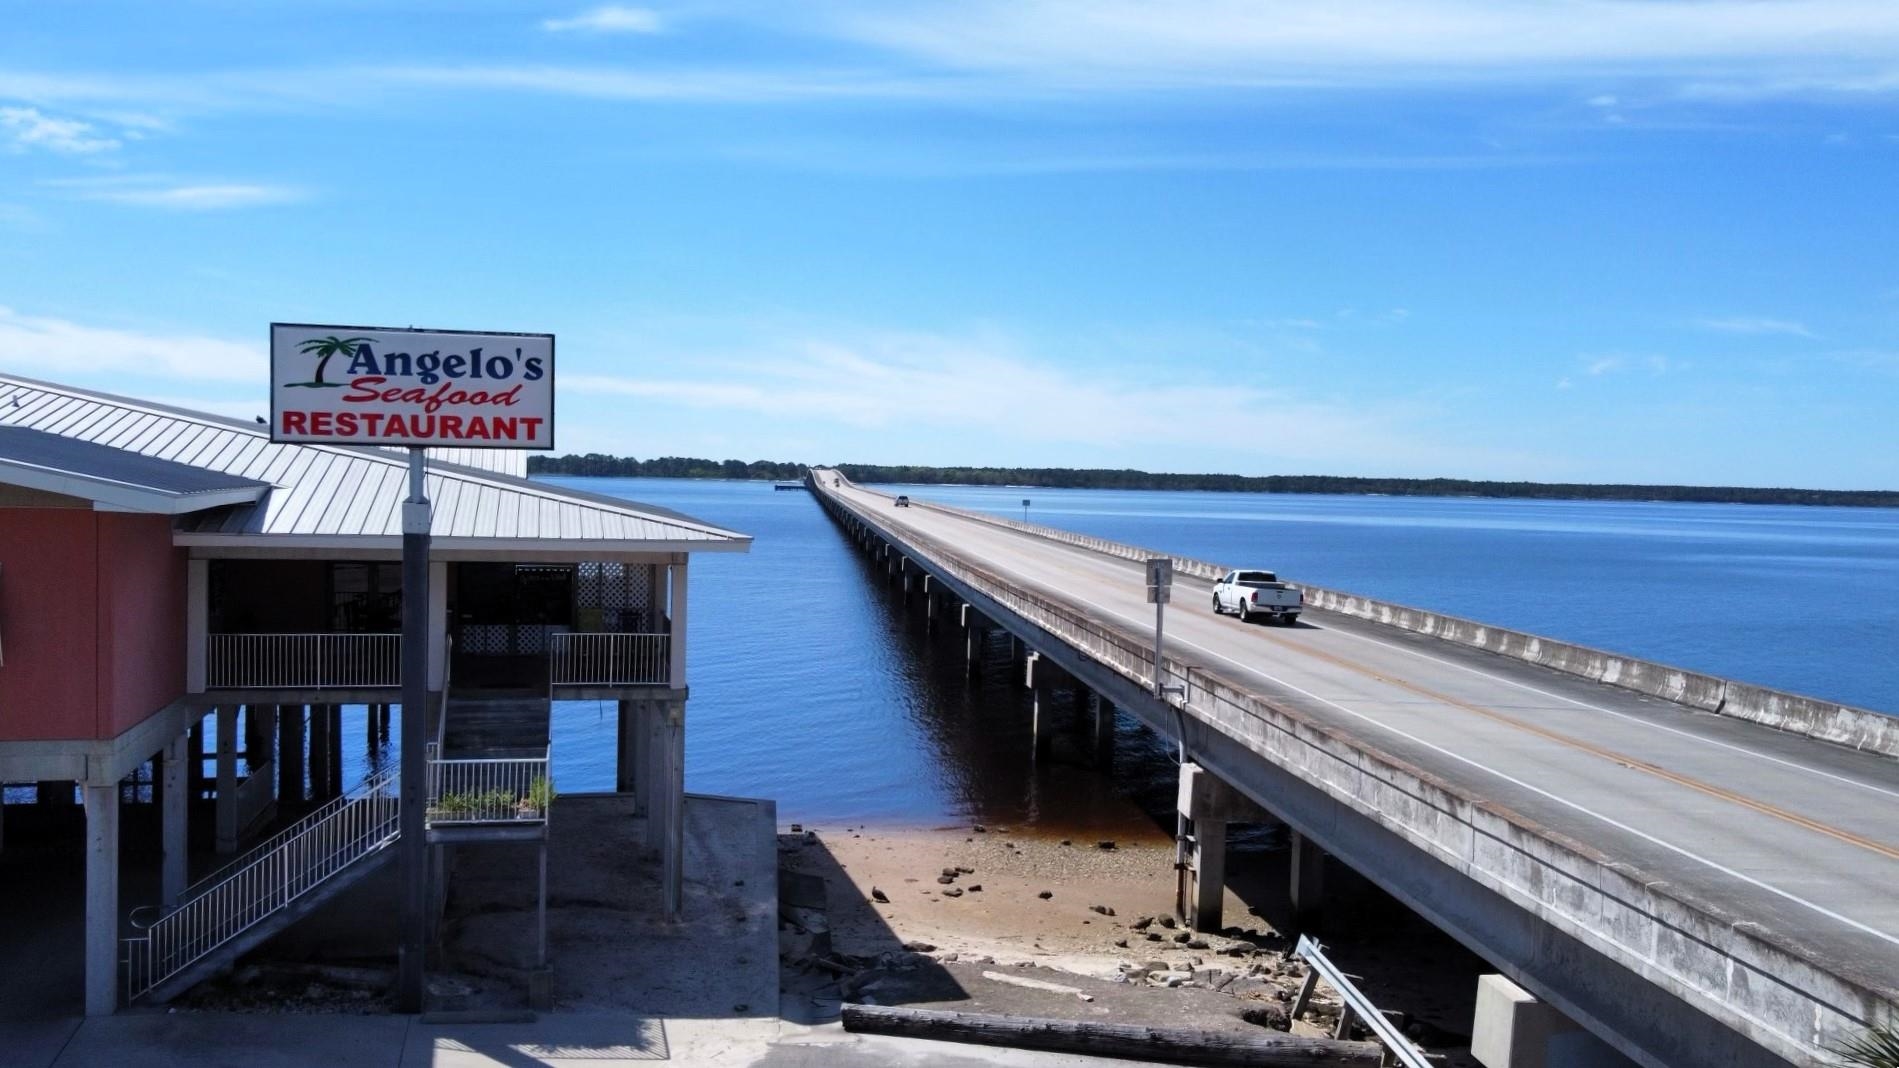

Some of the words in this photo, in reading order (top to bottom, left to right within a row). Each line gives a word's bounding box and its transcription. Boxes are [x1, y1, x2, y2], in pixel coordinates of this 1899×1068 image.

[347, 343, 543, 385] Angelo's
[342, 376, 523, 413] Seafood
[282, 411, 543, 440] RESTAURANT
